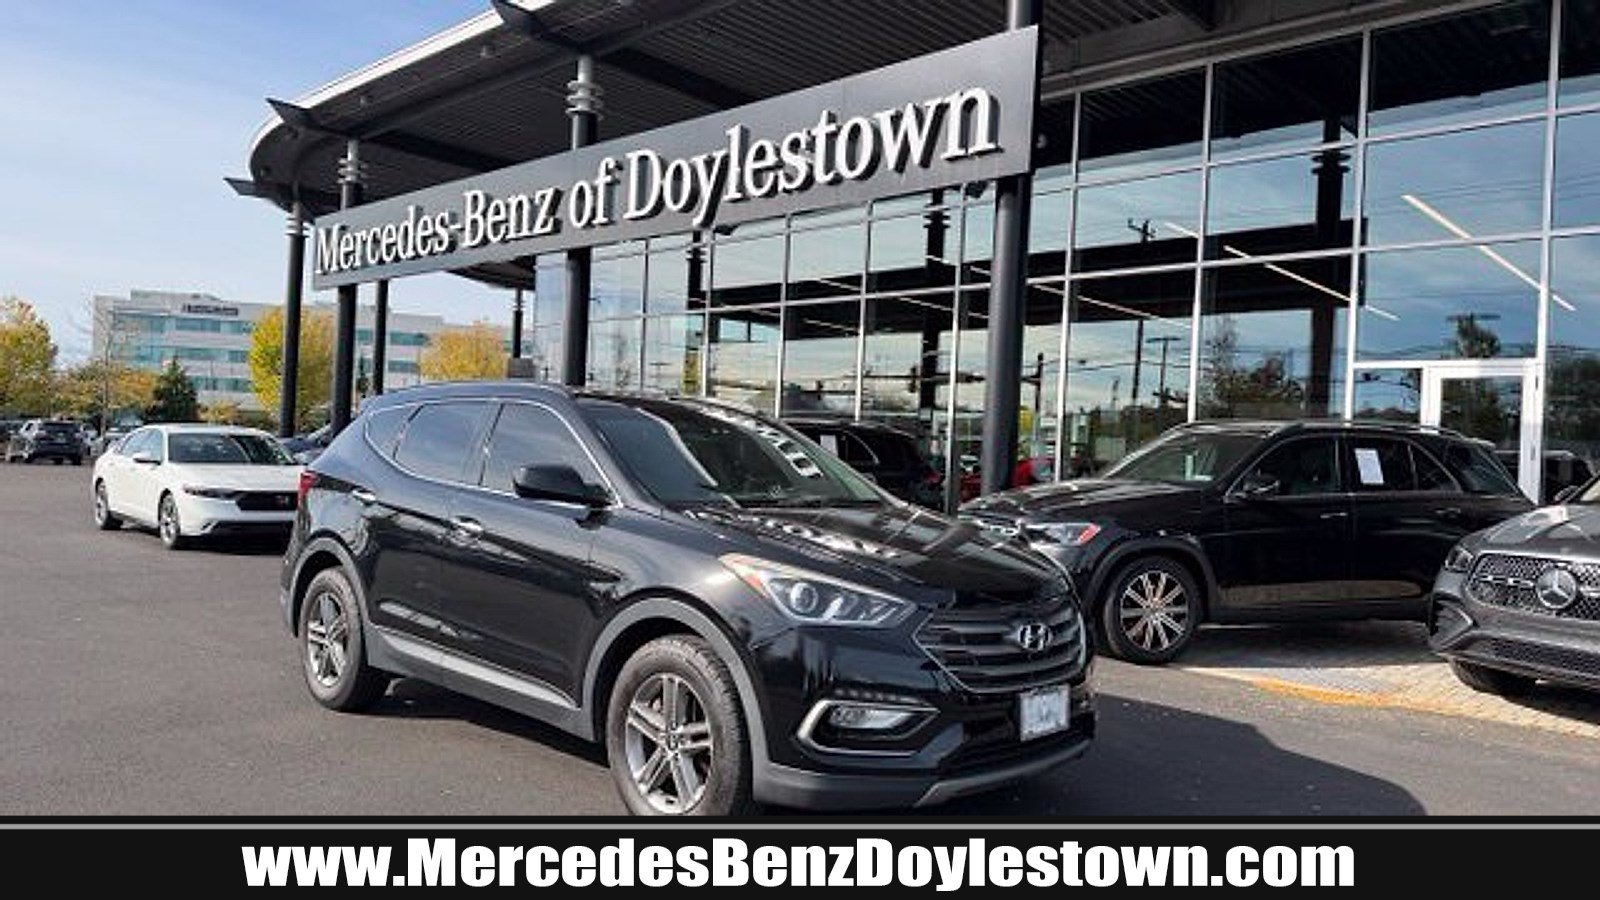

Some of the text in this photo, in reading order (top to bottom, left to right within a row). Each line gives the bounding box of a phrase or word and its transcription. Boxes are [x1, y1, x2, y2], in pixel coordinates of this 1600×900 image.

[315, 87, 1001, 275] Mercedes-Benz of Doylestown
